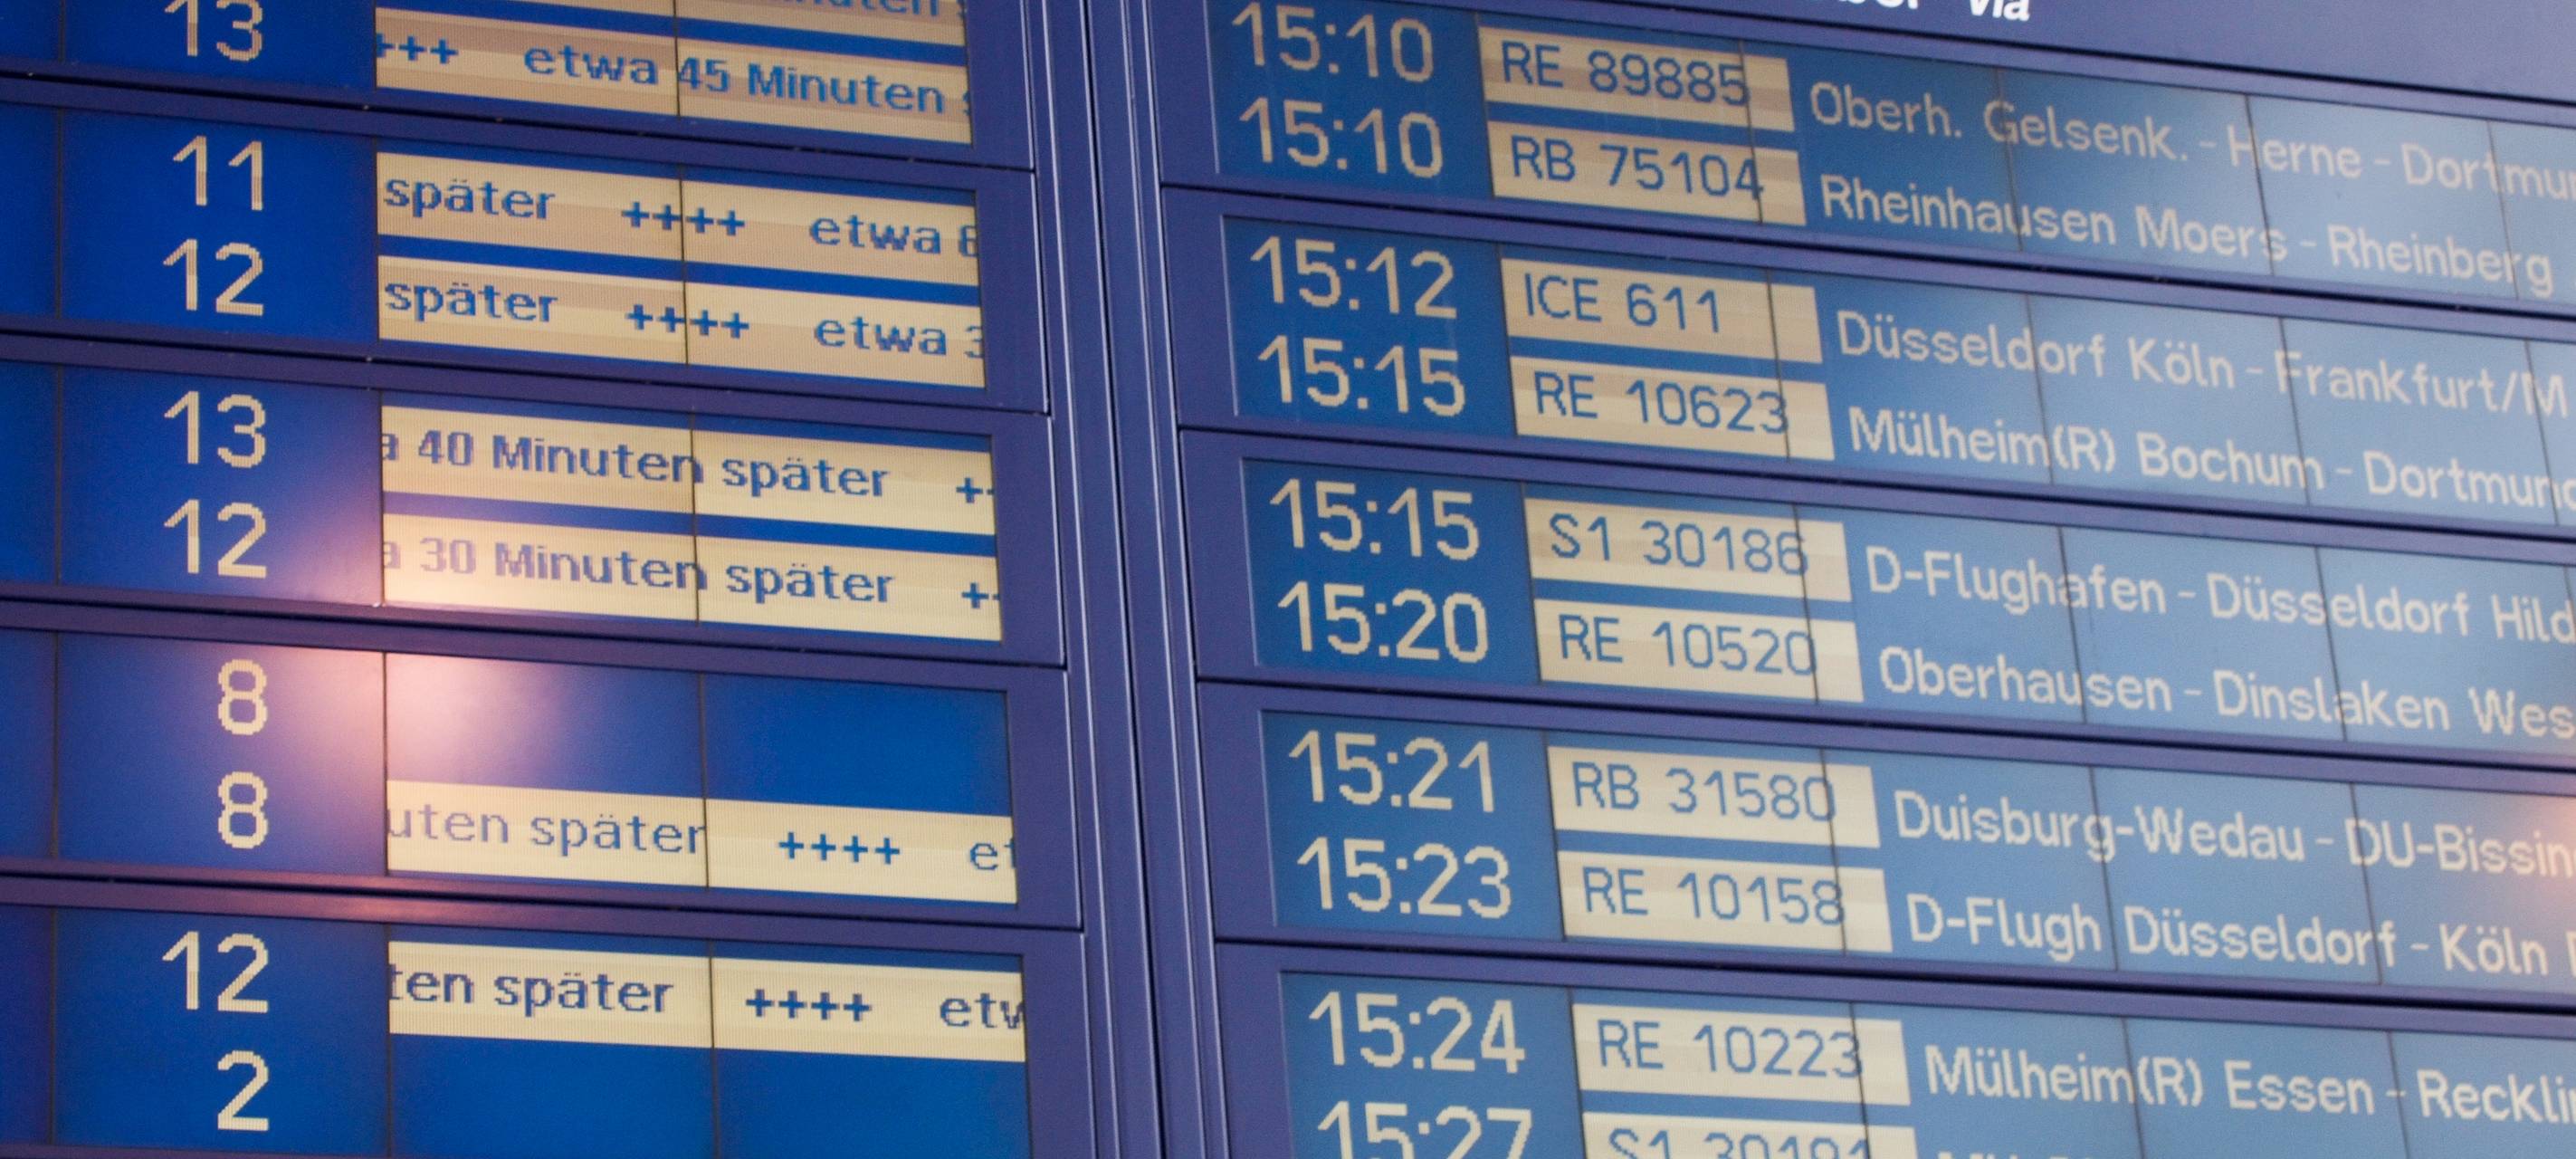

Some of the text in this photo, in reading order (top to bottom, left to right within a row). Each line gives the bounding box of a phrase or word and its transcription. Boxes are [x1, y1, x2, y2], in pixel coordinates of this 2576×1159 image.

[164, 0, 263, 62] 13
[1232, 2, 1433, 82] 15:10
[524, 45, 658, 85] etwa
[678, 56, 730, 93] 45
[748, 62, 944, 113] Minuten
[1502, 42, 1750, 108] RE 89885
[172, 135, 262, 211] 11
[1239, 97, 1444, 178] 15:10
[1512, 136, 1763, 200] RB 75104
[1811, 82, 1961, 139] Oberh.
[1983, 101, 2189, 162] Gelsenk.
[2227, 124, 2361, 180] Herne
[2401, 142, 2576, 201] Dortmu
[383, 177, 555, 219] später
[808, 214, 941, 255] etwa
[1821, 174, 2116, 247] Rheinhausen
[2136, 206, 2287, 263] Moers
[2328, 225, 2554, 300] Rheinberg
[163, 238, 263, 316] 12
[1250, 235, 1458, 319] 15:12
[1524, 274, 1721, 333] ICE 611
[384, 281, 558, 322] später
[815, 316, 947, 357] etwa
[1257, 335, 1465, 417] 15:15
[1837, 309, 2107, 378] Düsseldorf
[2128, 337, 2237, 389] Köln
[2274, 350, 2569, 419] Frankfurt/M
[164, 390, 267, 468] 13
[1534, 372, 1789, 435] RE 10623
[418, 429, 473, 466] 40
[492, 435, 703, 484] Minuten
[721, 456, 890, 497] später
[1848, 407, 2116, 473] Mülheim(R)
[2137, 432, 2325, 491] Bochum
[164, 499, 267, 579] 12
[1269, 479, 1479, 560] 15:15
[1550, 513, 1808, 577] S1 30186
[419, 537, 476, 574] 30
[495, 542, 707, 590] Minuten
[725, 563, 895, 604] später
[1865, 545, 2167, 616] D-Flughafen
[2207, 573, 2471, 638] Düsseldorf
[1277, 580, 1488, 662] 15:20
[1558, 614, 1818, 676] RE 10520
[217, 659, 268, 735] 8
[1880, 645, 2172, 713] Oberhausen
[2214, 670, 2450, 733] Dinslaken
[2469, 687, 2574, 739] Wes
[217, 771, 268, 848] 8
[1289, 731, 1494, 813] 15:21
[1571, 761, 1837, 822] RB 31580
[387, 803, 509, 844] uten
[530, 814, 705, 857] später
[1895, 790, 2304, 862] Duisburg-Wedau
[1296, 837, 1511, 919] 15:23
[1582, 867, 1845, 926] RE 10158
[162, 931, 269, 1013] 12
[1907, 895, 2103, 961] D-Flugh
[2125, 905, 2397, 968] Düsseldorf
[2440, 924, 2548, 976] Köln
[494, 972, 673, 1018] später
[1309, 992, 1525, 1073] 15:24
[1598, 1019, 1863, 1078] RE 10223
[1925, 1044, 2204, 1107] Mülheim(R)
[2225, 1059, 2374, 1116] Essen
[217, 1049, 269, 1131] 2
[1318, 1101, 1531, 1159] 15:27
